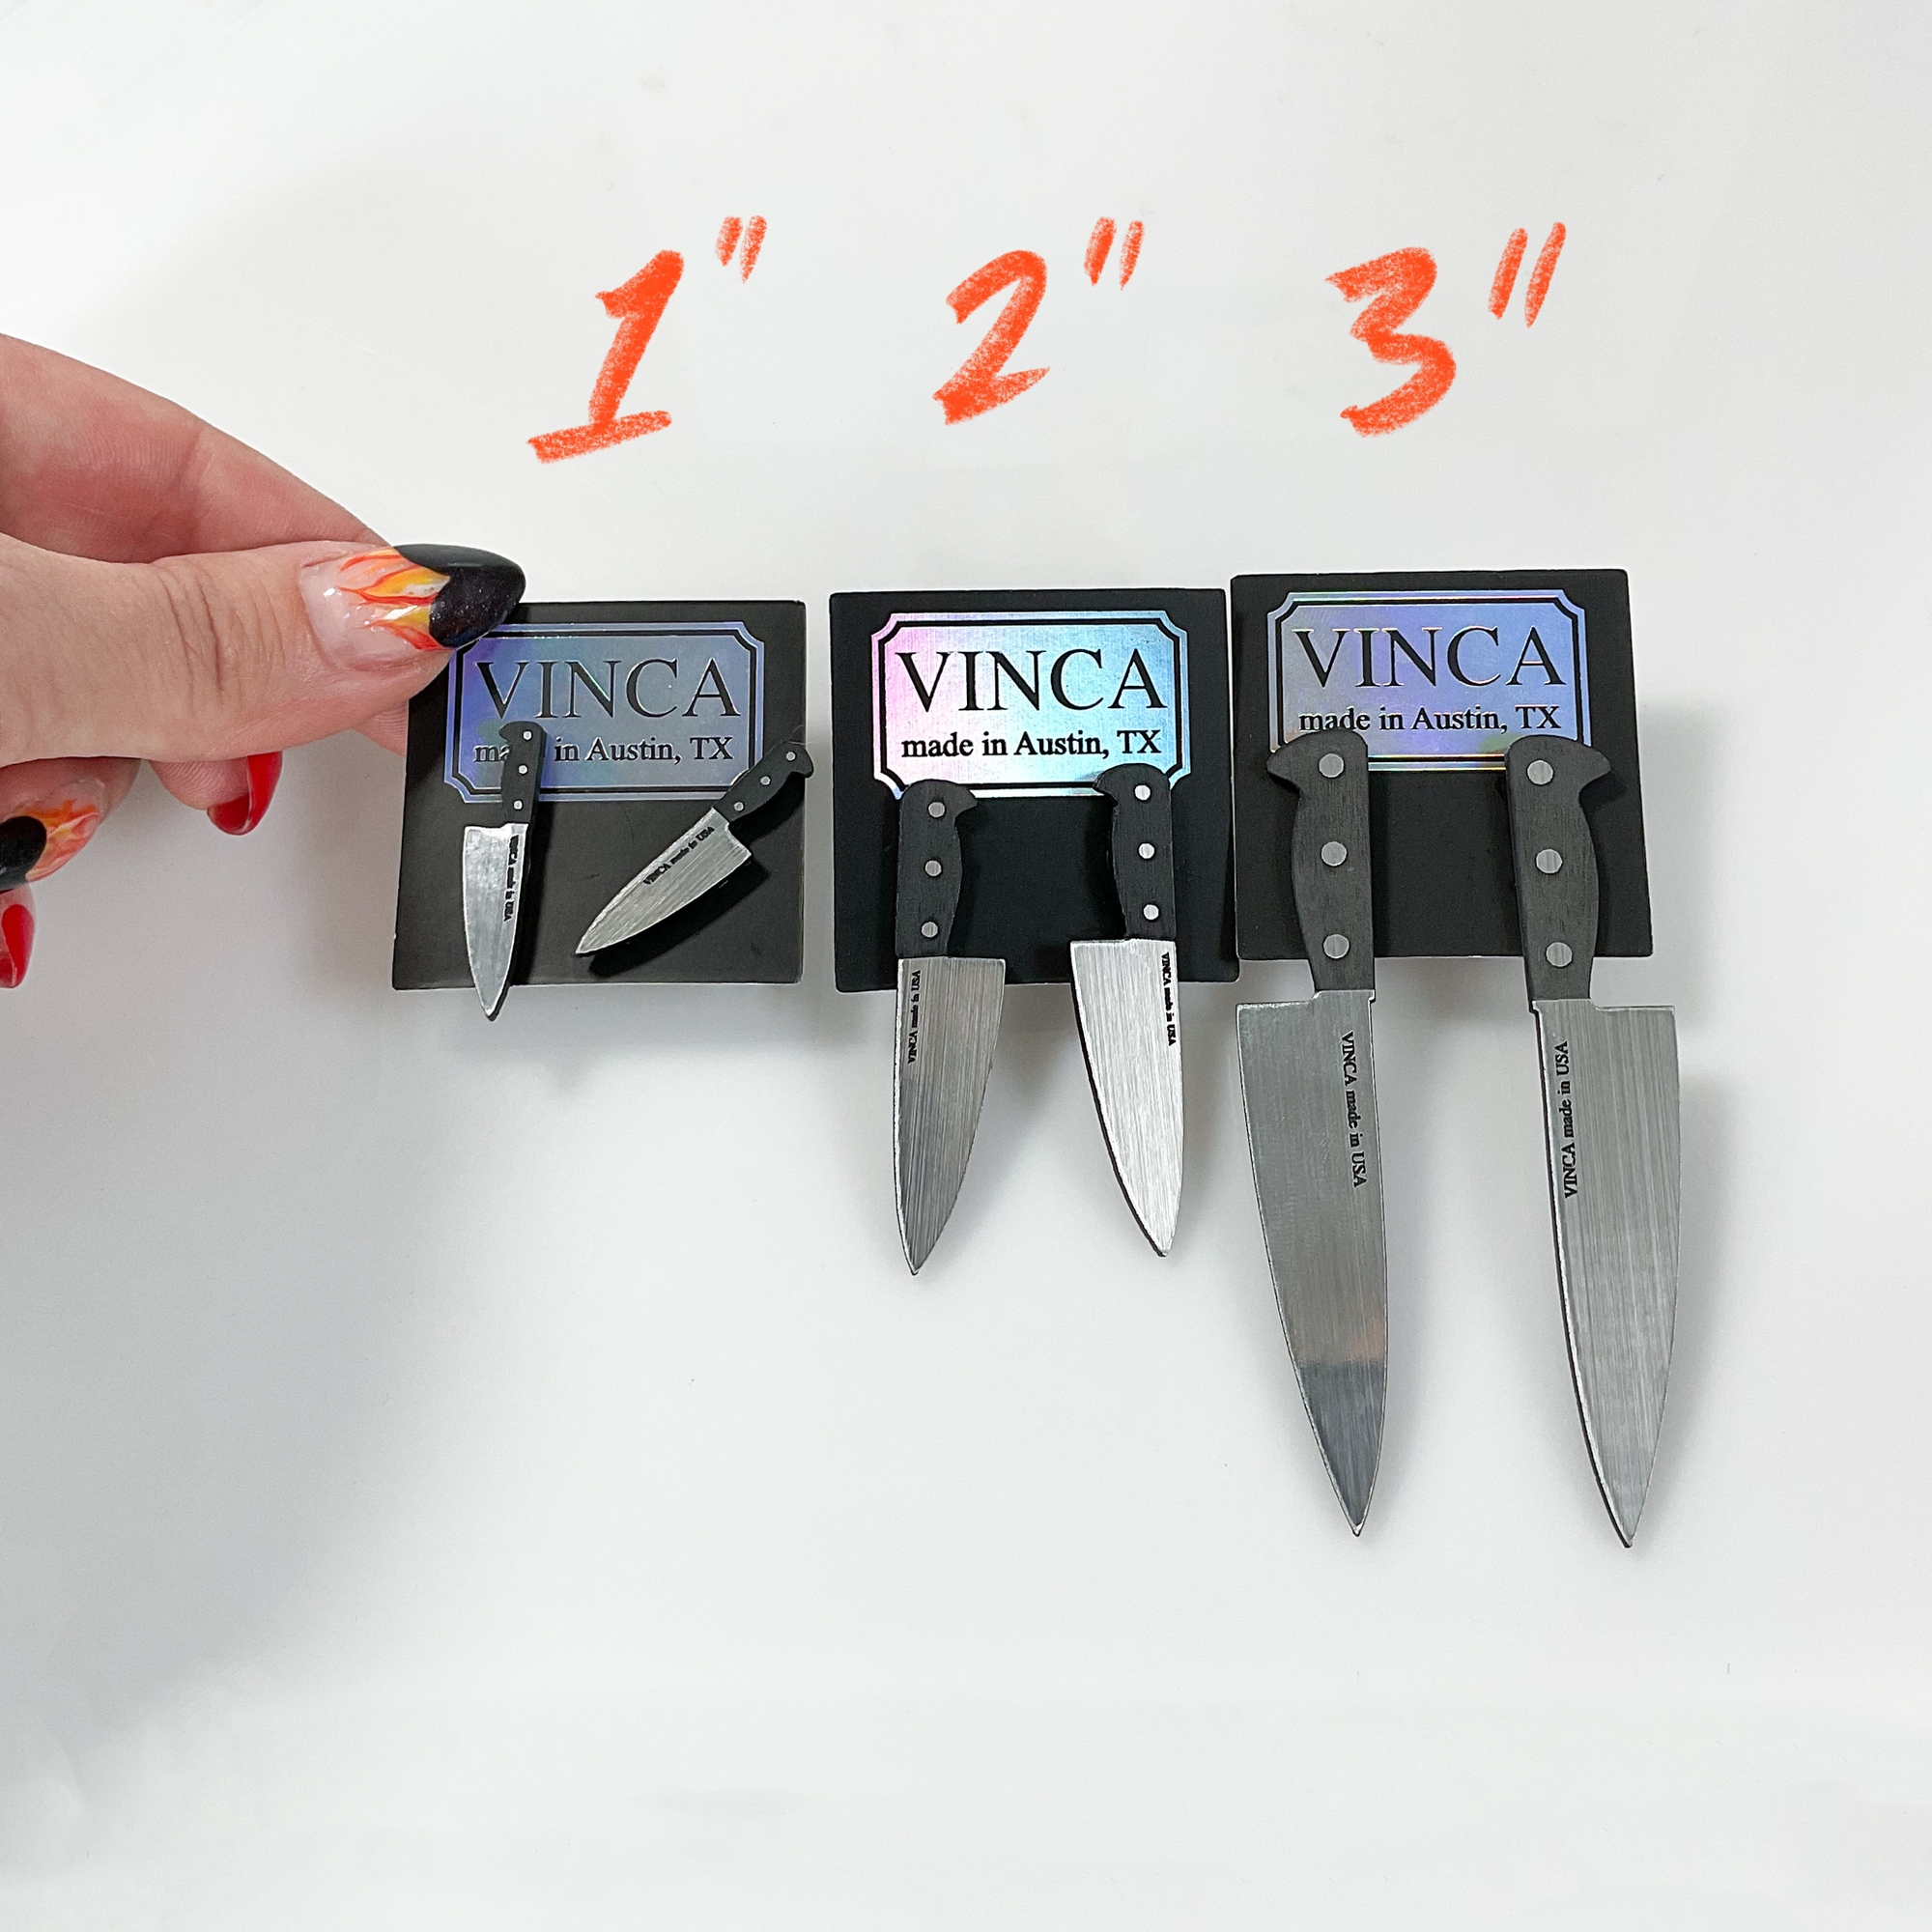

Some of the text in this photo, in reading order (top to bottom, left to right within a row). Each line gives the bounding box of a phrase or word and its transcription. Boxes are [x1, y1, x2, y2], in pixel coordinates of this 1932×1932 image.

[1291, 625, 1567, 688] VINCA
[474, 657, 742, 721] VINCA
[895, 647, 1168, 713] VINCA
[1297, 704, 1562, 735] made in Austin, TX
[554, 736, 580, 763] in
[584, 736, 682, 765] Austin,
[689, 735, 735, 761] TX
[900, 729, 1162, 760] made in Austin, TX
[910, 969, 922, 992] USA
[1161, 951, 1172, 986] VINCA
[908, 1030, 918, 1065] VINCA
[1166, 1024, 1177, 1047] USA
[1340, 1030, 1368, 1188] VINCA made in USA
[1553, 1040, 1578, 1199] VINCA made in USA
